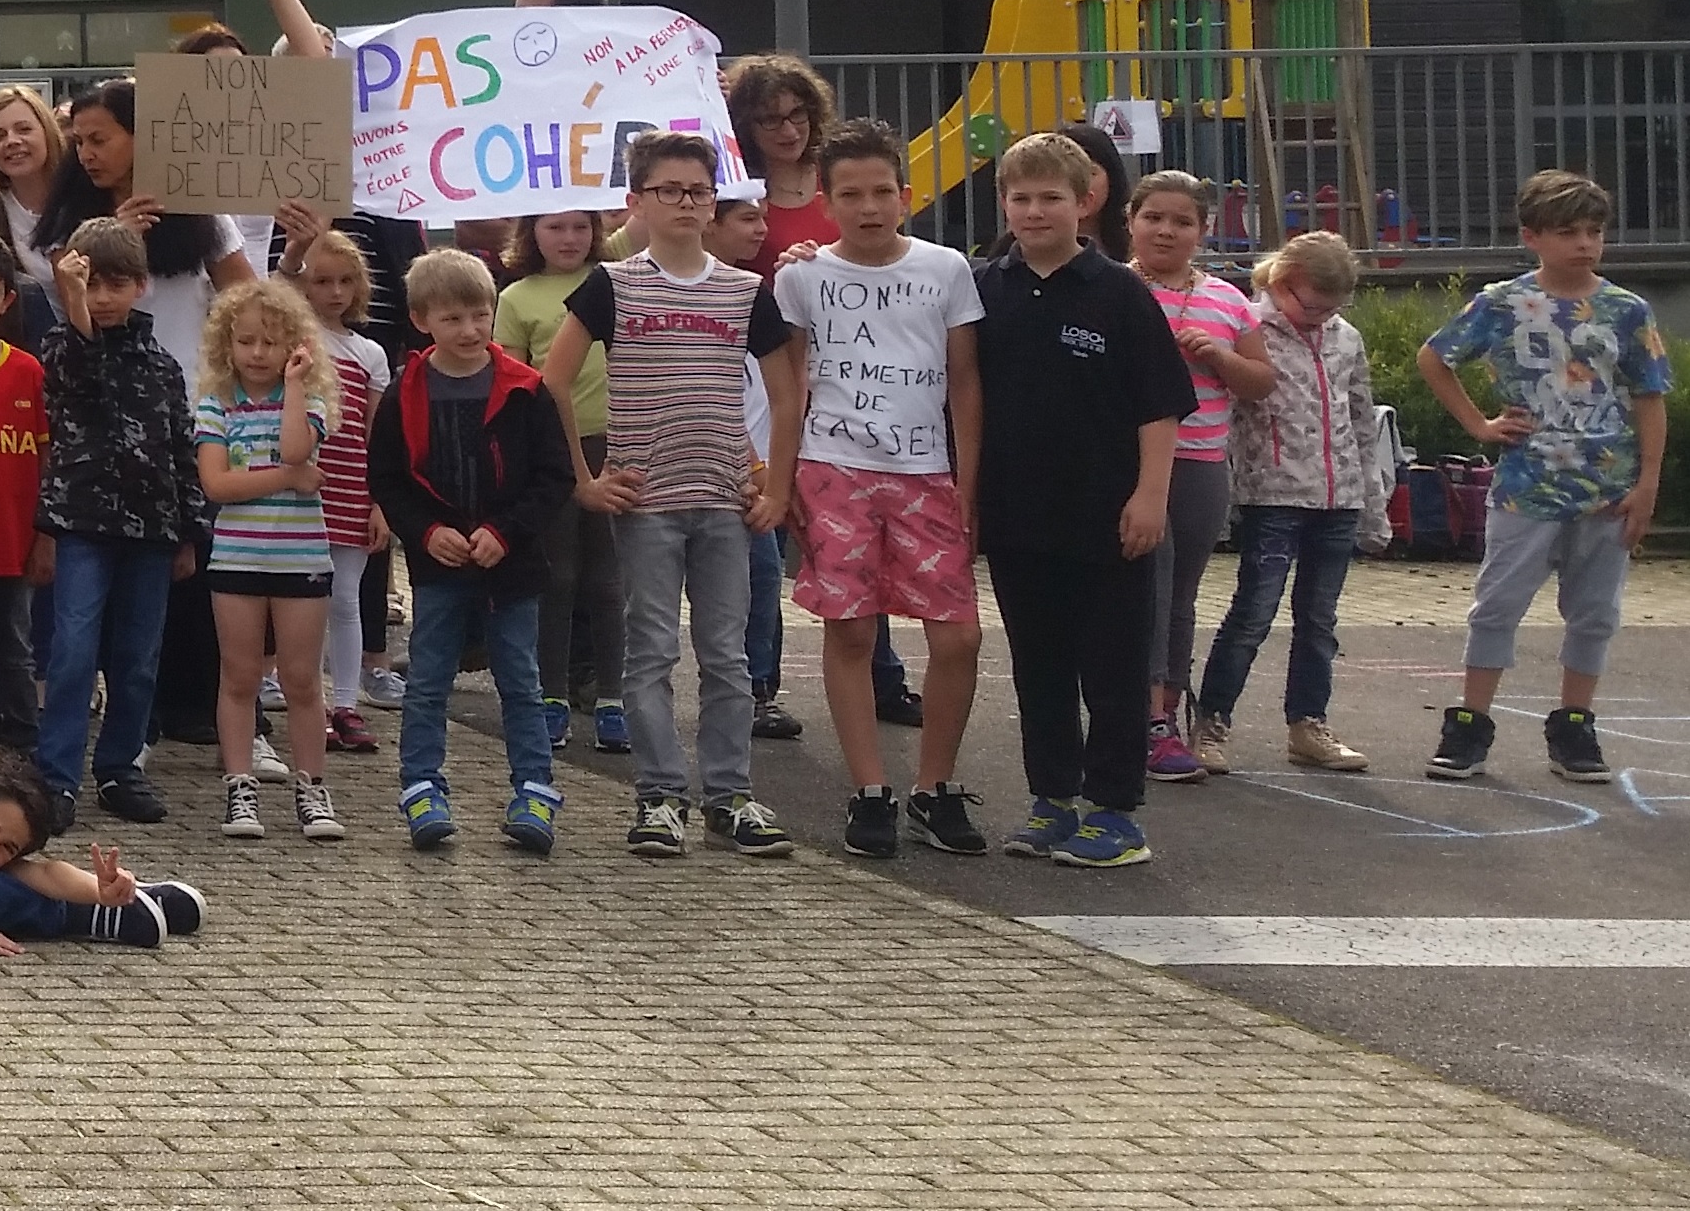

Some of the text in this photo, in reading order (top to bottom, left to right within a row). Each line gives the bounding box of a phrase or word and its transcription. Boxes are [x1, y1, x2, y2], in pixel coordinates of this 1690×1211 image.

[584, 36, 615, 67] NON
[205, 58, 268, 91] NON
[357, 34, 503, 113] PAS
[173, 90, 266, 123] A LA
[151, 121, 326, 161] FERMETURE
[363, 143, 406, 168] NOTRE
[167, 161, 341, 202] DE CLASSE
[366, 165, 412, 196] ÉCOLE
[826, 318, 876, 348] LA
[854, 390, 888, 412] DE
